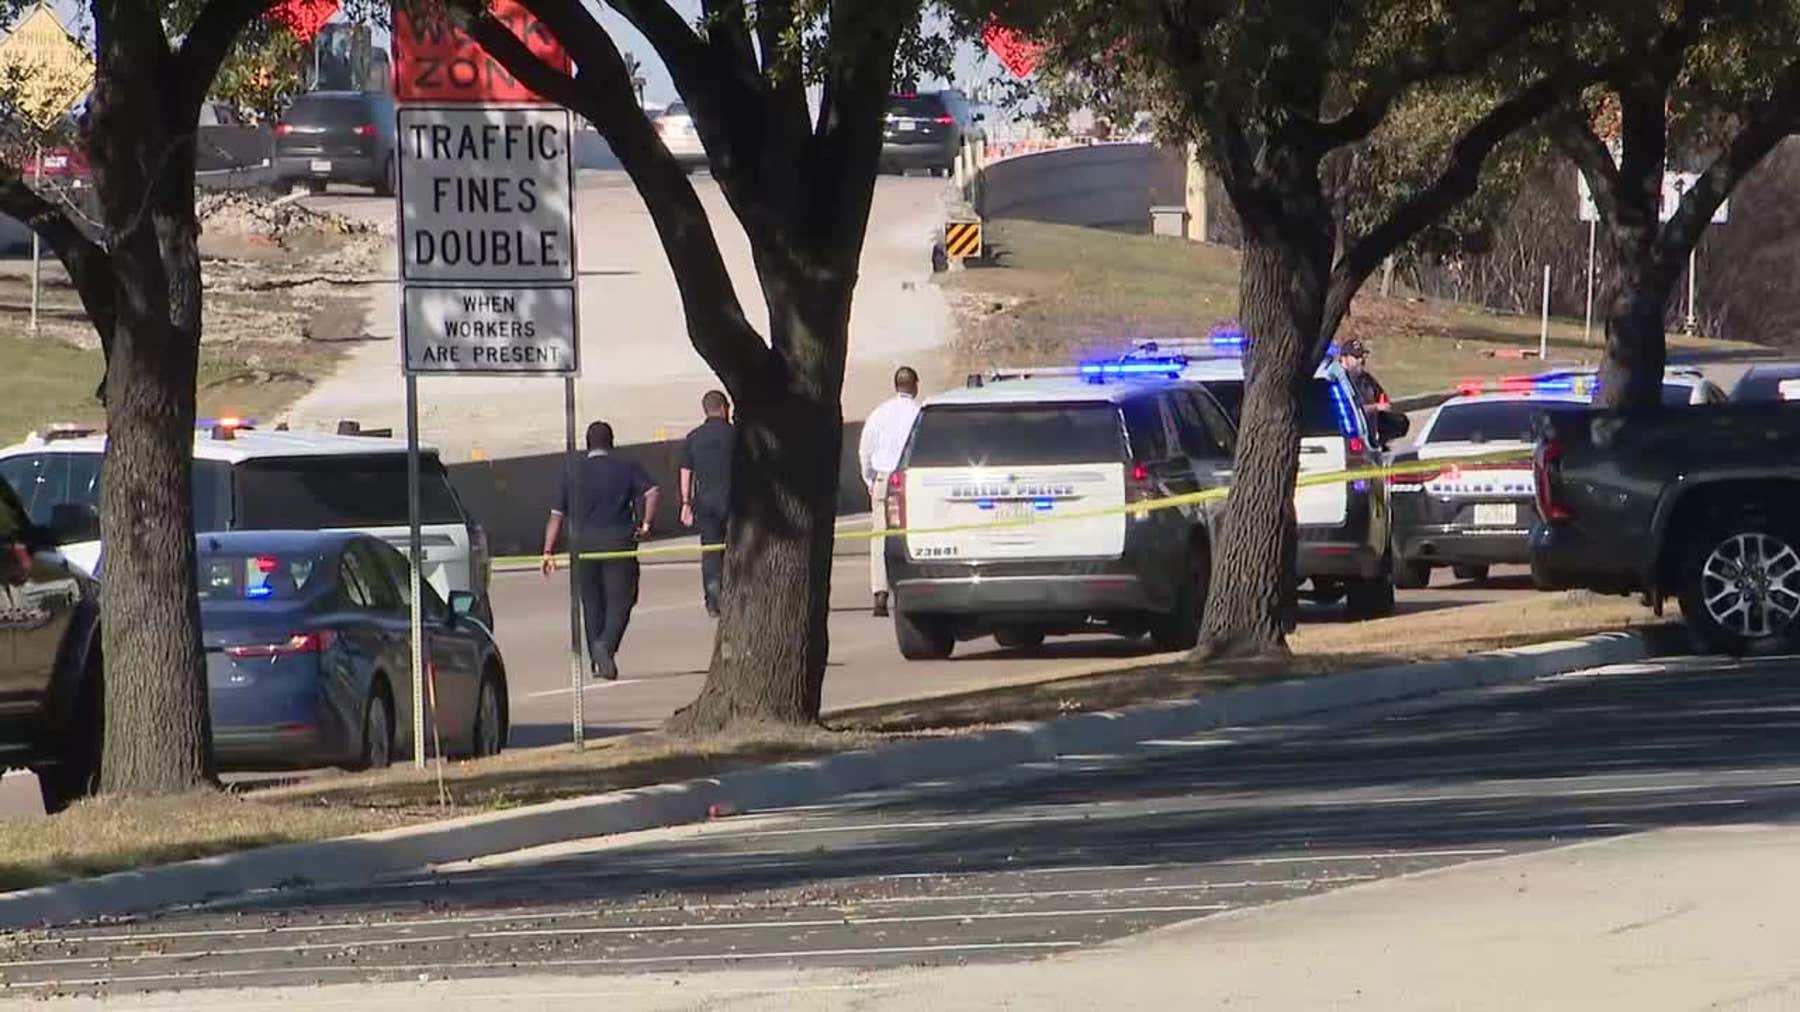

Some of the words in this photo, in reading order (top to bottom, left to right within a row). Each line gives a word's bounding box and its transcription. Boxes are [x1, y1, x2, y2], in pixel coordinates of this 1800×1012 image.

[414, 57, 517, 89] ZON
[410, 124, 558, 161] TRAFFIC
[434, 177, 537, 213] FINES
[416, 229, 560, 267] DOUBLE
[463, 296, 515, 313] WHEN
[445, 321, 536, 338] WORKERS
[423, 347, 460, 363] ARE
[474, 346, 560, 363] PRESENT
[1016, 483, 1073, 496] POLICE
